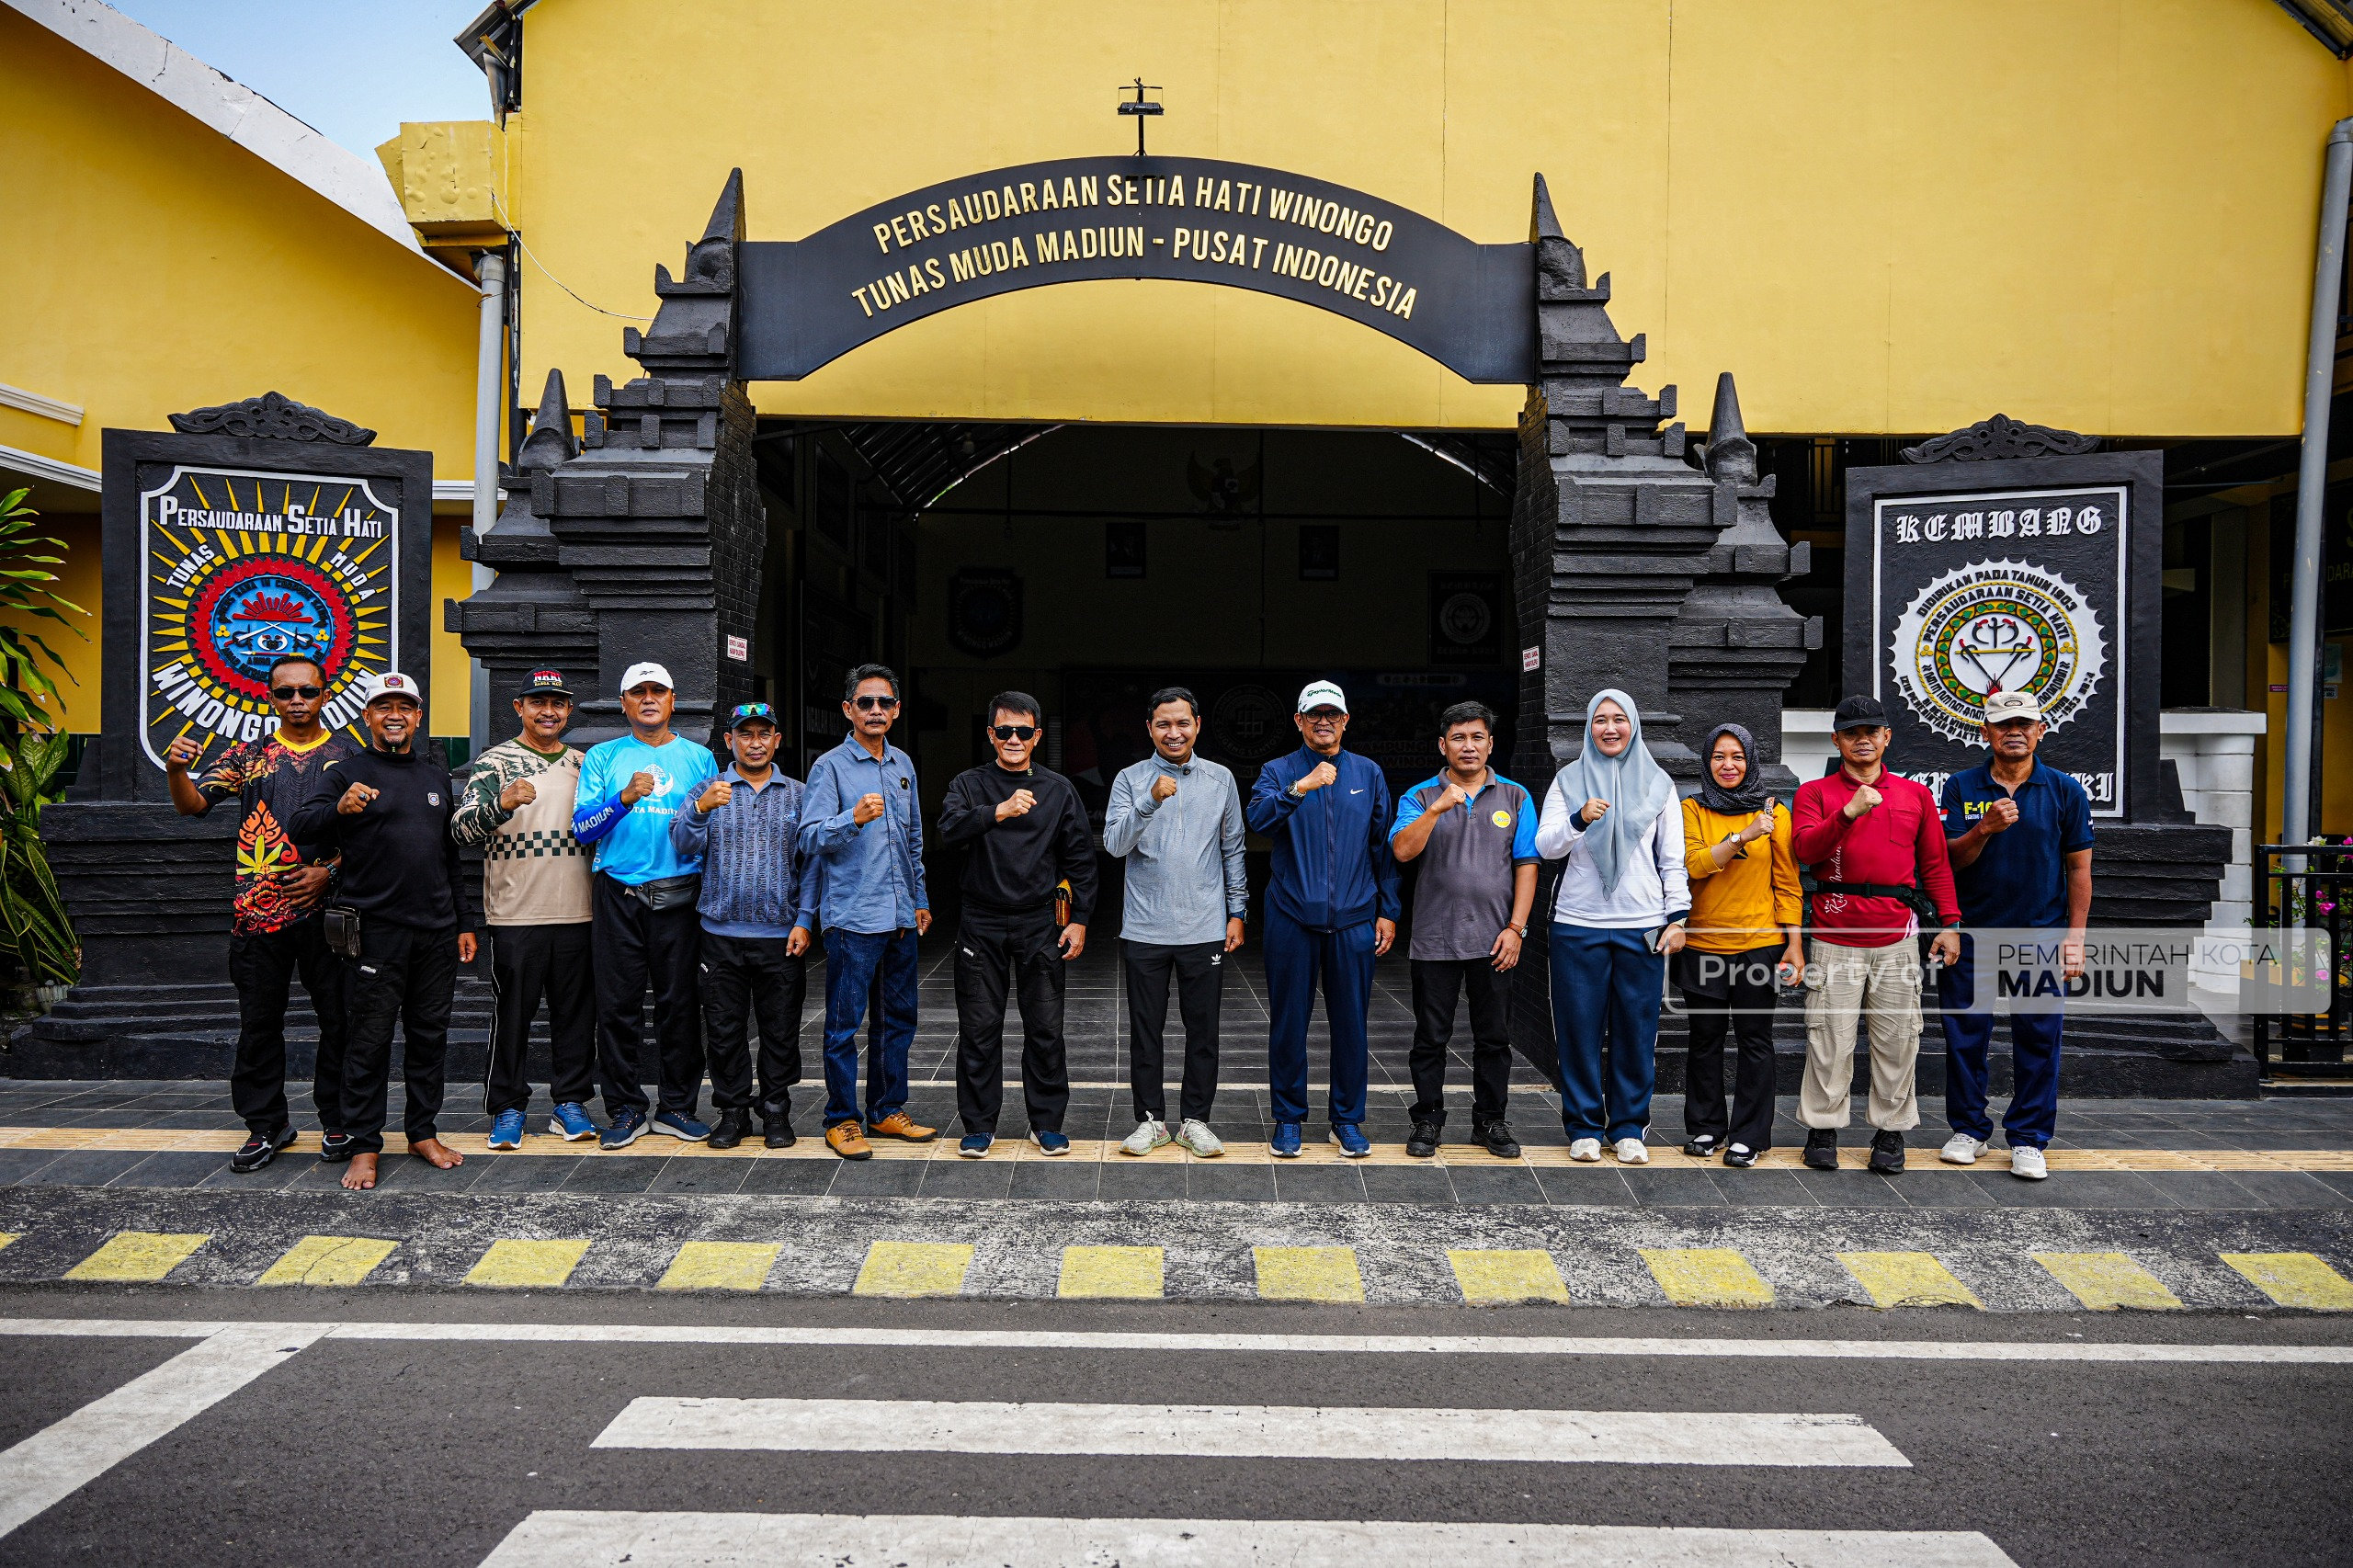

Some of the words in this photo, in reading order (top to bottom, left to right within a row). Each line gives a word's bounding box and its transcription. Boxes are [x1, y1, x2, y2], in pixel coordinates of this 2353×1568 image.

[873, 176, 1098, 255] PERSAUDARAAN
[1107, 174, 1185, 206] SETIA
[1195, 176, 1263, 215] HATI
[1269, 187, 1393, 252] WINONGO
[851, 257, 946, 320] TUNAS
[949, 236, 1029, 283] MUDA
[1035, 226, 1143, 264] MADIUN
[1173, 227, 1268, 269] PUSAT
[1272, 243, 1417, 321] INDONESIA
[287, 505, 337, 536] SETIA
[344, 507, 382, 539] HATI
[1896, 506, 2101, 543] KEMBANG
[166, 544, 215, 589] TUNAS
[329, 551, 376, 601] MUDA
[1916, 574, 1972, 618] DIDIRIKAN
[1975, 570, 2008, 582] PADA
[2012, 570, 2052, 591] TAHUN
[2050, 585, 2077, 611] 1903
[1923, 587, 2013, 642] PERSAUDARAAN
[2016, 589, 2051, 614] SETIA
[2049, 613, 2070, 639] HATI
[320, 668, 376, 730] DIUN
[533, 670, 563, 682] NKRI
[1949, 718, 1981, 734] WINONG
[578, 806, 614, 834] MADIUN
